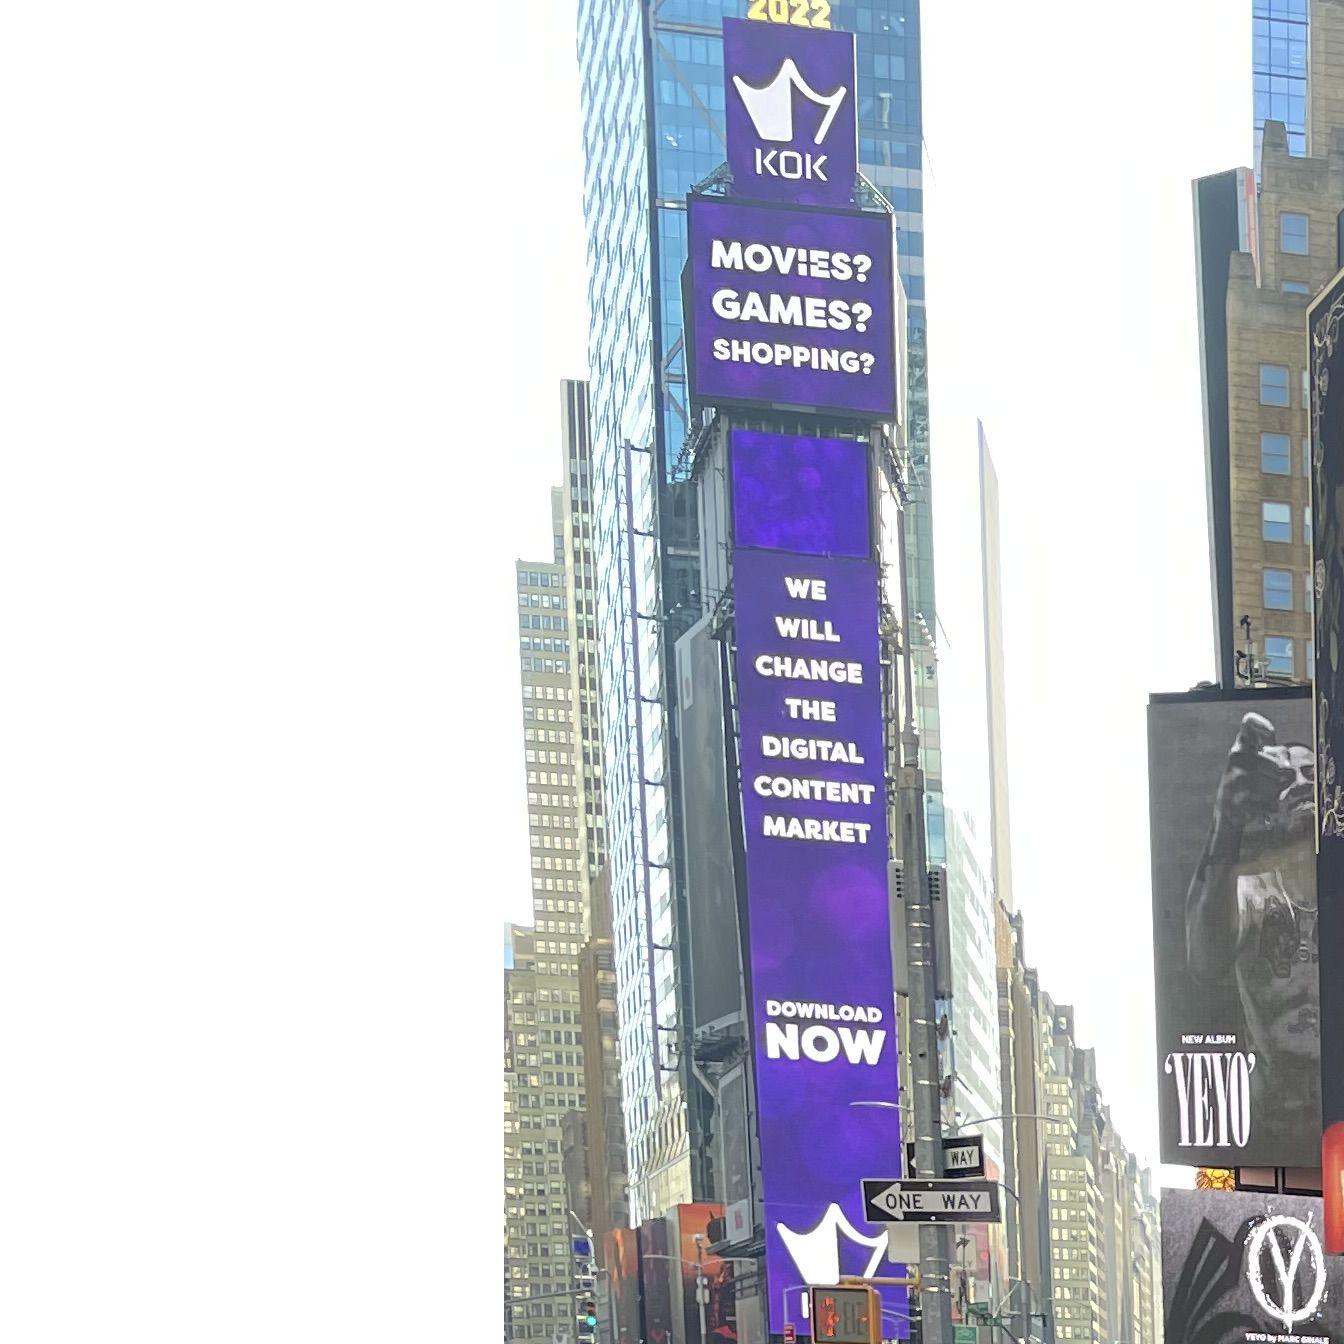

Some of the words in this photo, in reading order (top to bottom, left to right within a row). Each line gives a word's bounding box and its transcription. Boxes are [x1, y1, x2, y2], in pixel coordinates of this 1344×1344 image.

[747, 0, 832, 29] 2022
[755, 148, 828, 182] KOK
[711, 240, 872, 283] MOVIES?
[712, 289, 873, 332] GAMES?
[712, 338, 875, 375] SHOPPING?
[785, 576, 827, 600] WE
[775, 616, 841, 642] WILL
[755, 655, 863, 684] CHANGE
[785, 698, 836, 722] THE
[762, 735, 864, 764] DIGITAL
[754, 775, 875, 804] CONTENT
[763, 815, 870, 844] MARKET
[766, 1000, 883, 1023] DOWNLOAD
[765, 1022, 887, 1065] NOW
[1181, 1034, 1204, 1044] NEW
[1204, 1034, 1236, 1044] ALBUM
[950, 1150, 975, 1166] WAY
[885, 1194, 923, 1210] ONE
[941, 1194, 982, 1210] WAY
